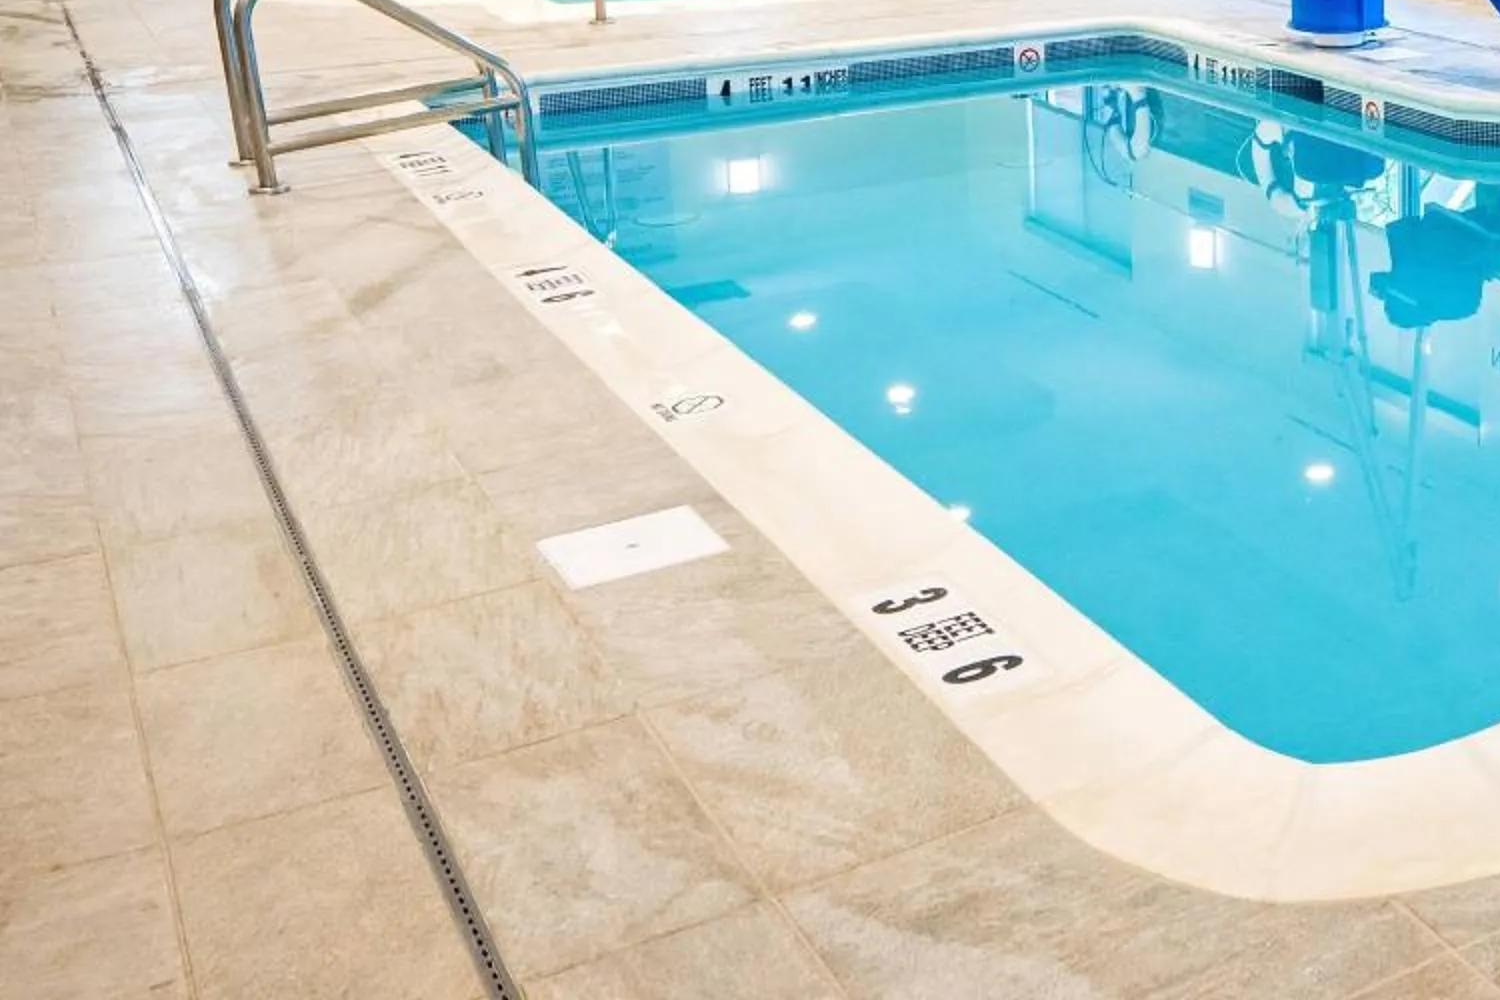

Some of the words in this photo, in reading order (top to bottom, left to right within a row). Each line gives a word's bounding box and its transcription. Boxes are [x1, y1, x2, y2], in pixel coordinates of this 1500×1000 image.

[872, 587, 948, 614] 3
[898, 622, 955, 653] DEEP
[937, 611, 995, 643] FEET
[942, 655, 1024, 684] 6
